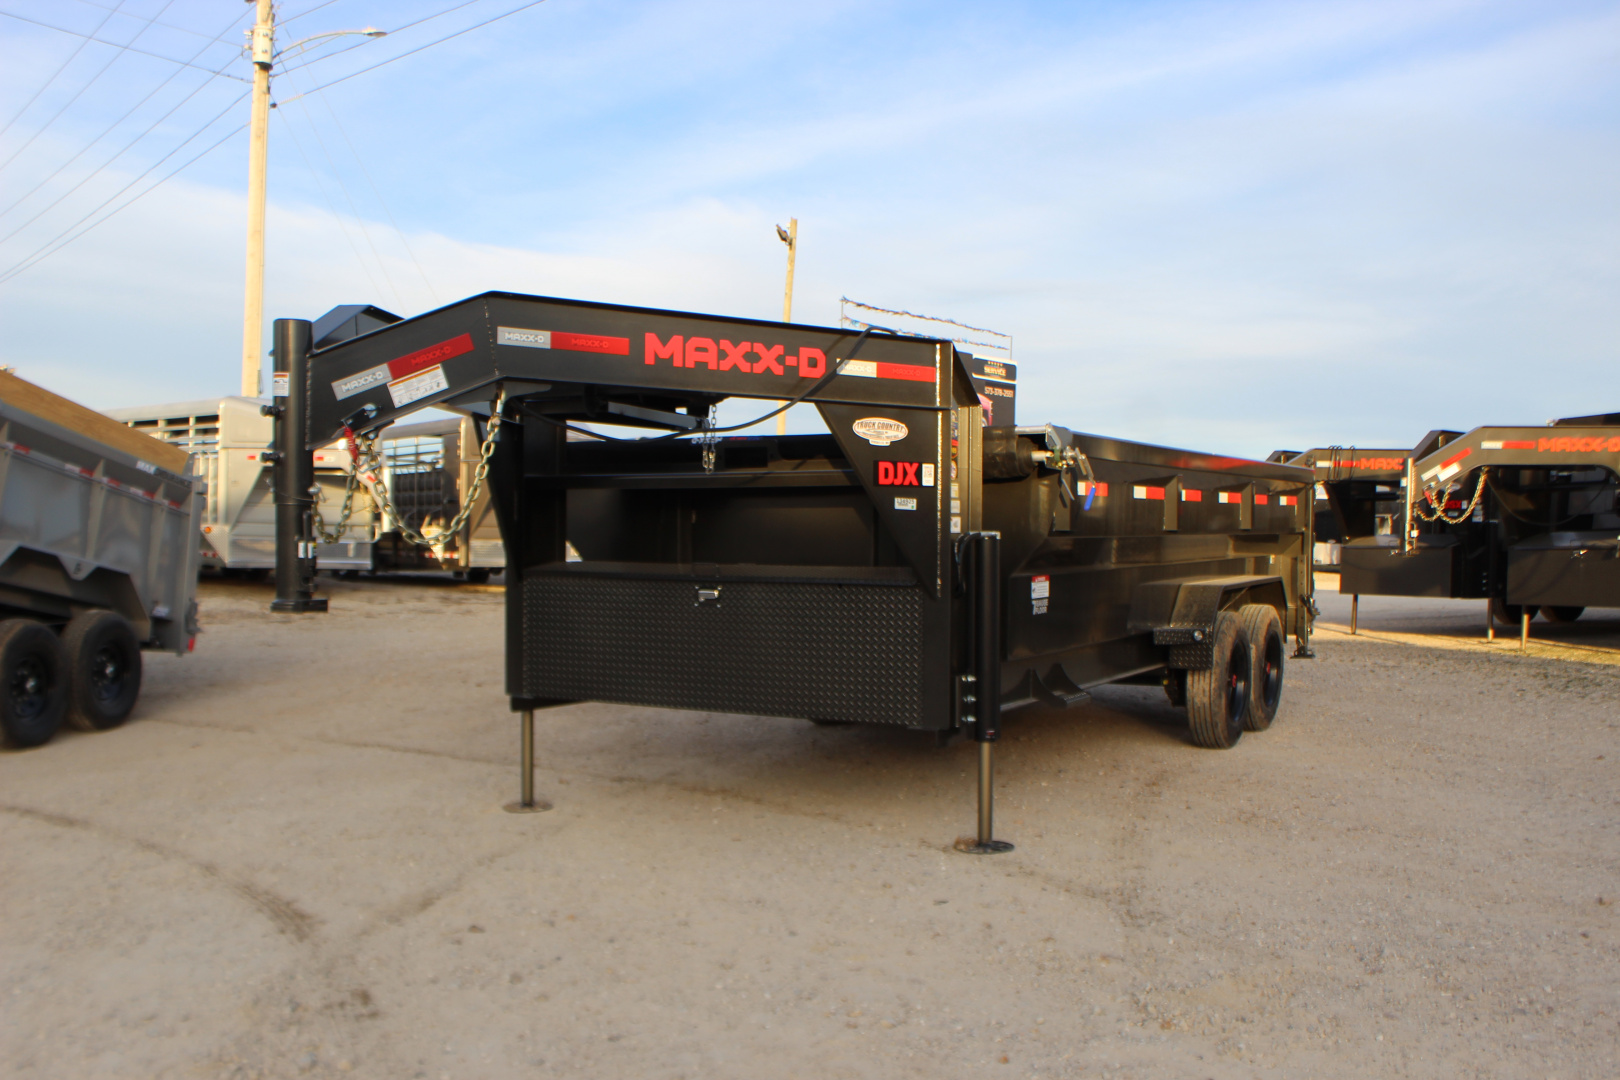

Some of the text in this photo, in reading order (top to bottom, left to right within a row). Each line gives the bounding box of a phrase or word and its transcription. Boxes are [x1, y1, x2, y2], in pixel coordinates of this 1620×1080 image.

[504, 332, 610, 349] MAXX-D MAXX-D
[644, 332, 827, 379] MAXX-D
[341, 370, 384, 393] MAXX-D
[410, 345, 453, 367] MAXX-D
[857, 421, 905, 432] TRUCK COUNTRY
[878, 460, 919, 486] DJX
